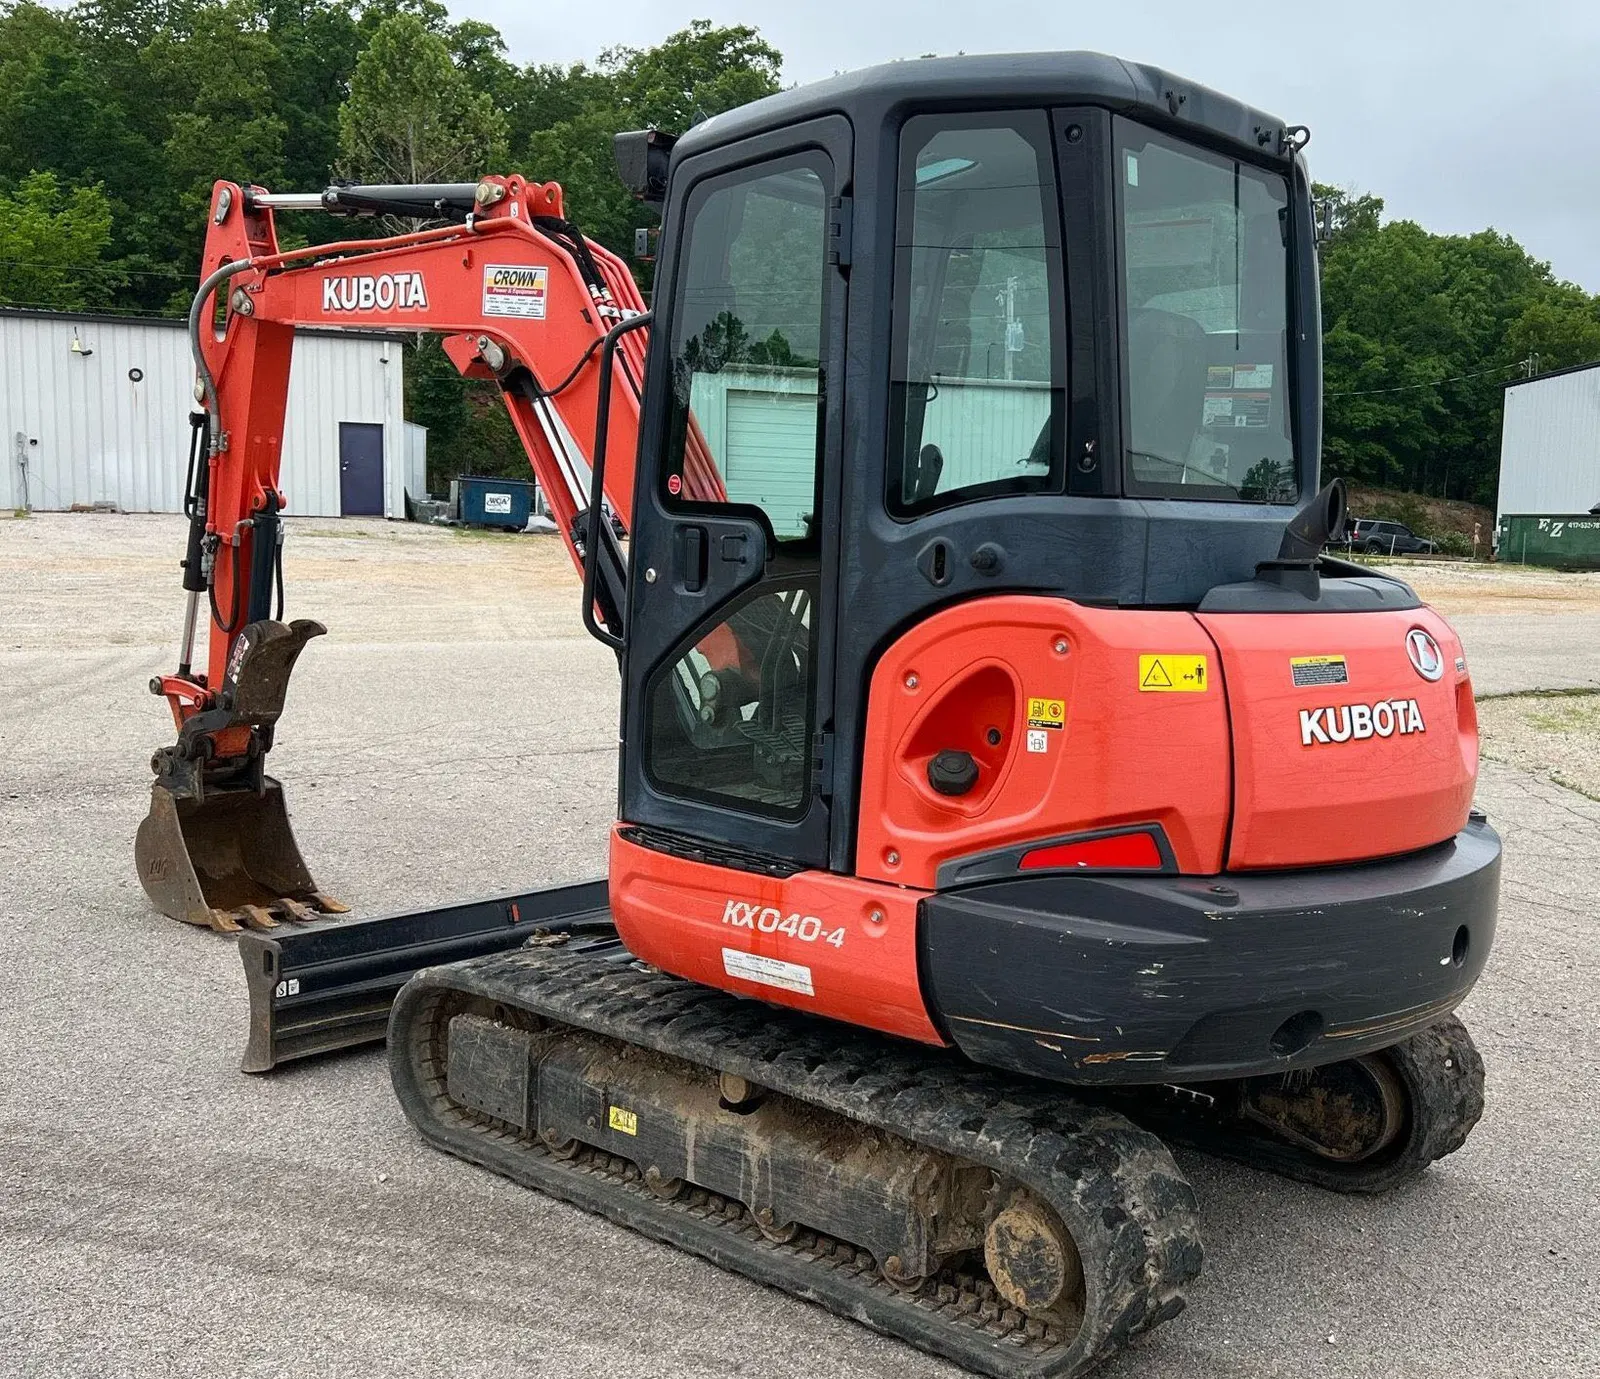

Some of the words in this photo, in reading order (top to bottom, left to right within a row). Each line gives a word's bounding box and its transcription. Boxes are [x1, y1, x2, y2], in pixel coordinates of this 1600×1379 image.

[323, 272, 427, 311] KUBOTA
[494, 270, 537, 287] CROWN
[1299, 699, 1426, 746] KUBOTA
[721, 899, 846, 948] KX040-4
